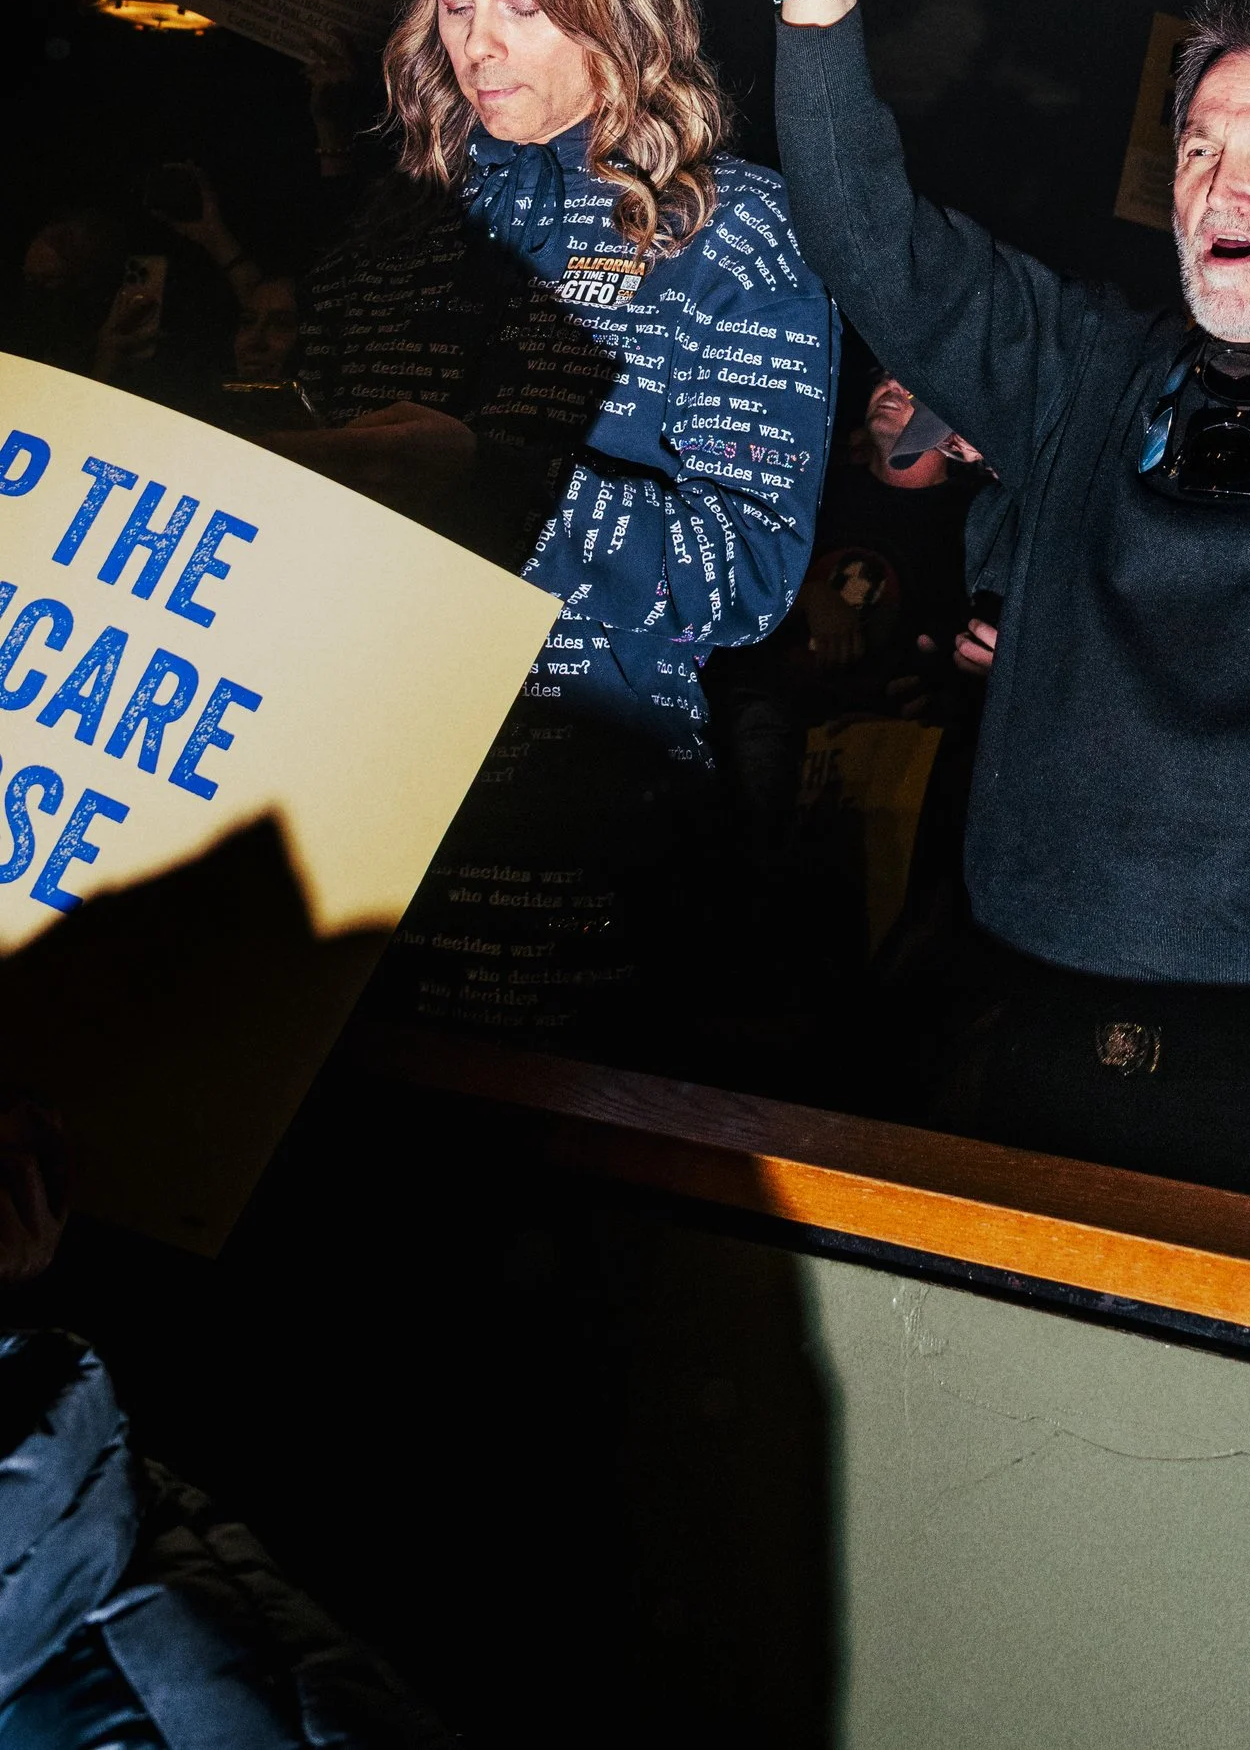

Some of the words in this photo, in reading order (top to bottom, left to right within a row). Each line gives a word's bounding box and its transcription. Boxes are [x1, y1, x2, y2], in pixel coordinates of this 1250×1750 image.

[553, 194, 614, 210] ecides
[733, 202, 780, 248] decides
[776, 252, 799, 289] war.
[562, 270, 581, 281] IT'S
[582, 270, 604, 282] TIME
[606, 272, 620, 284] TO
[566, 256, 646, 277] CALIFORNIA
[754, 256, 777, 293] war.
[554, 279, 616, 306] #GTFO
[625, 303, 660, 315] war.
[528, 311, 557, 324] who
[563, 313, 628, 333] decides
[635, 323, 669, 339] war.
[716, 318, 777, 341] decides
[785, 329, 821, 349] war.
[371, 360, 434, 379] decides
[518, 339, 546, 352] who
[551, 340, 617, 361] decides
[623, 350, 666, 371] war?
[702, 345, 763, 367] decides
[771, 356, 808, 374] war.
[527, 357, 557, 372] who
[562, 361, 630, 386] decides
[637, 375, 667, 395] war
[717, 367, 787, 391] decides
[794, 380, 826, 403] war.
[351, 383, 414, 401] decides
[728, 396, 768, 415] war.
[478, 400, 539, 417] decides
[546, 406, 588, 424] war?
[691, 414, 751, 433] decides
[758, 423, 796, 444] war.
[685, 455, 753, 481] decides
[760, 471, 795, 490] war
[749, 443, 812, 473] war?
[703, 495, 737, 562] decides
[742, 503, 782, 533] war?
[52, 455, 260, 629] THE
[534, 517, 558, 553] who
[582, 527, 600, 564] war.
[606, 514, 631, 555] war.
[669, 519, 693, 565] war?
[690, 515, 717, 583] decides
[708, 587, 723, 622] war
[567, 582, 594, 606] who
[643, 599, 668, 627] who
[545, 633, 585, 650] ides
[547, 659, 591, 676] war?
[0, 580, 263, 801] CARE
[522, 681, 562, 698] ides
[0, 762, 130, 915] SE
[447, 887, 482, 903] who
[488, 890, 564, 909] decides
[431, 932, 504, 956] decides
[509, 942, 557, 958] war?
